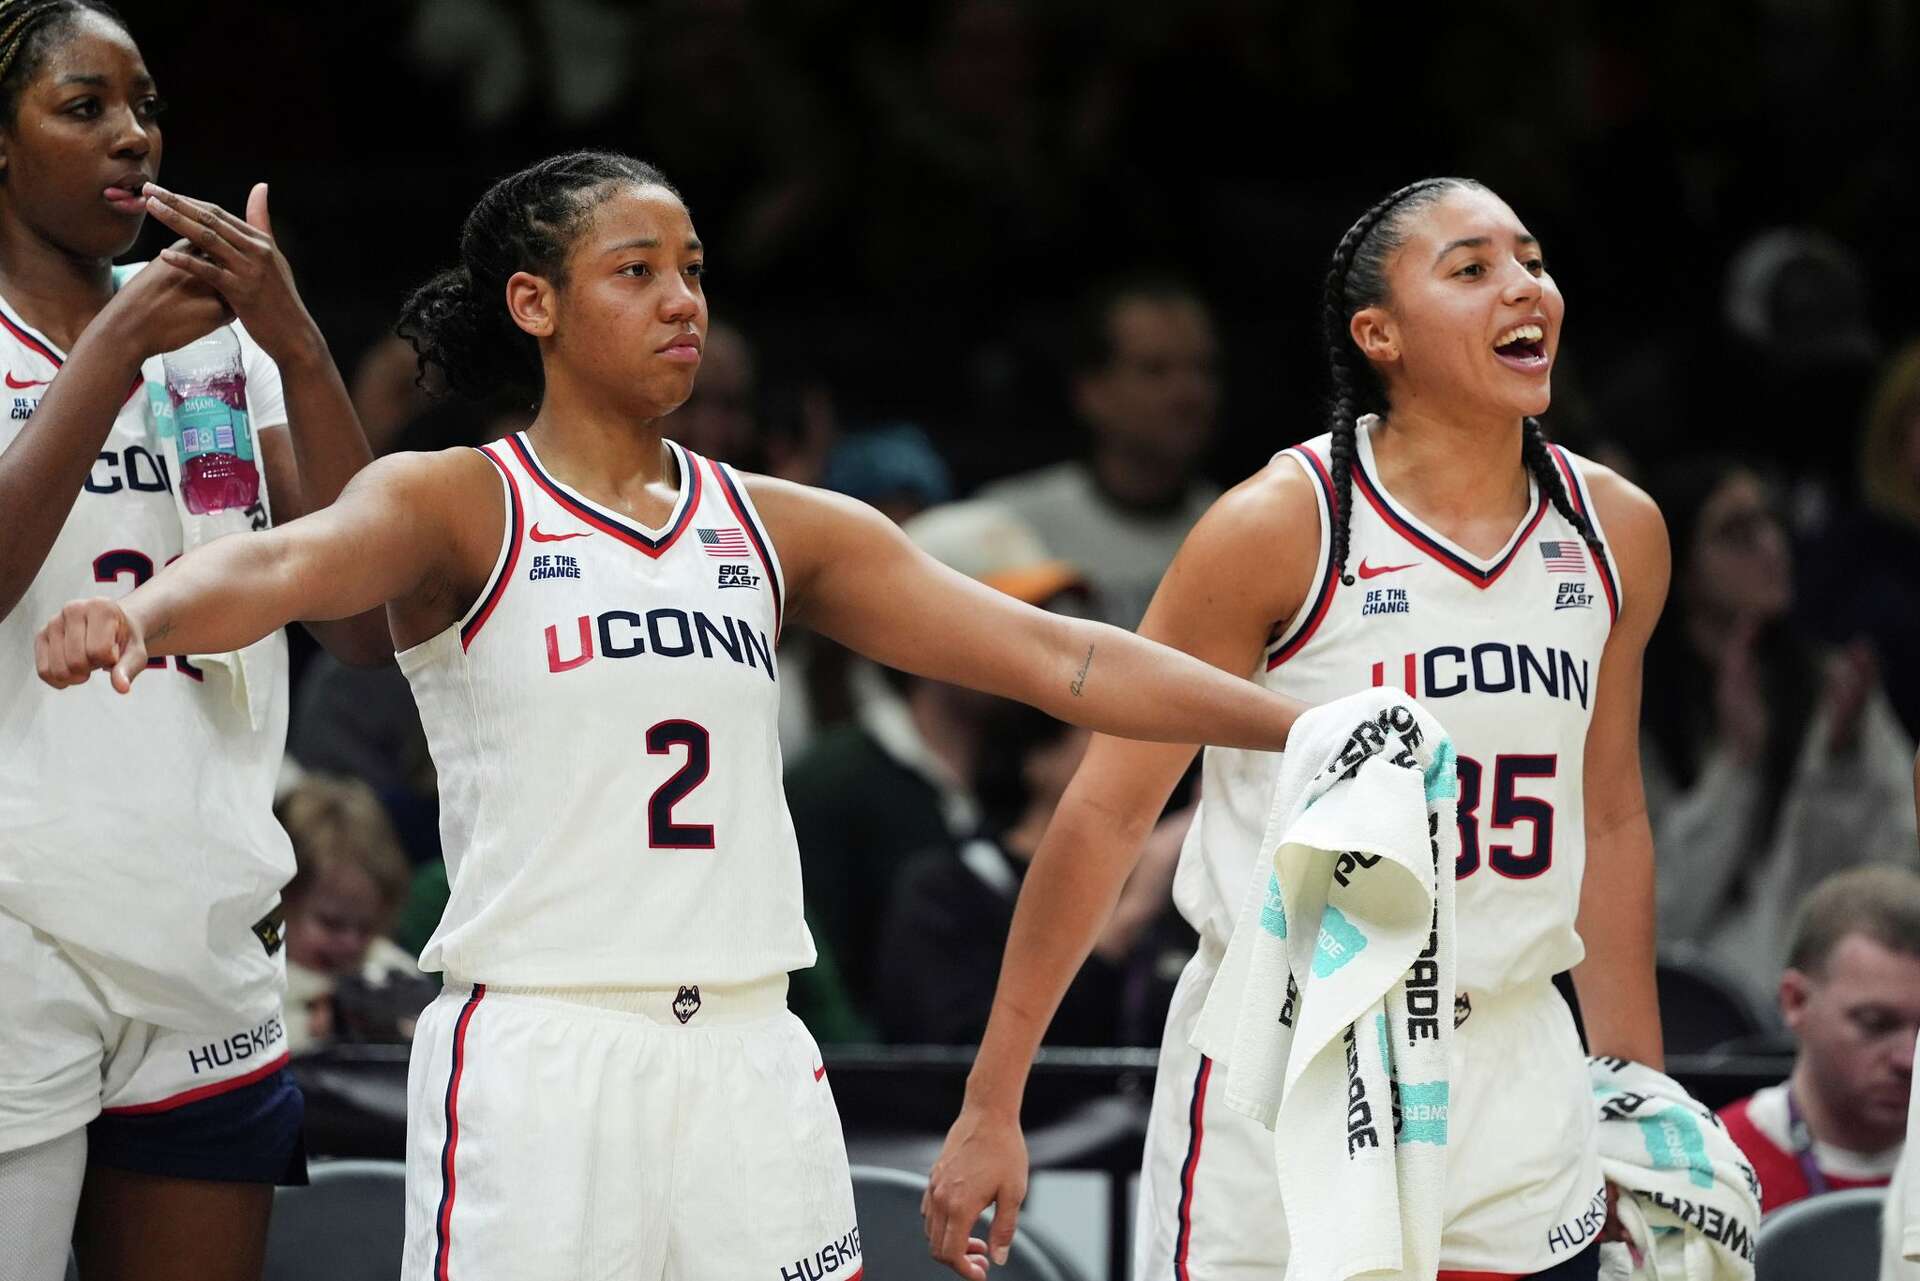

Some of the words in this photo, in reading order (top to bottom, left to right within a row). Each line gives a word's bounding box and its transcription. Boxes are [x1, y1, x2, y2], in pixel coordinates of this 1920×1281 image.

[11, 408, 34, 420] CHA
[533, 555, 552, 568] BE
[555, 554, 578, 568] THE
[529, 566, 581, 581] CHANGE
[718, 564, 750, 576] BIG
[718, 576, 761, 587] EAST
[1557, 582, 1585, 594] BIG
[1366, 589, 1383, 602] BE
[1387, 588, 1409, 601] THE
[1556, 594, 1594, 605] EAST
[1362, 600, 1410, 616] CHANGE
[544, 608, 775, 682] UCONN
[1372, 642, 1588, 710] UCONN
[645, 718, 716, 849] 2
[780, 1226, 863, 1281] HUSKIE
